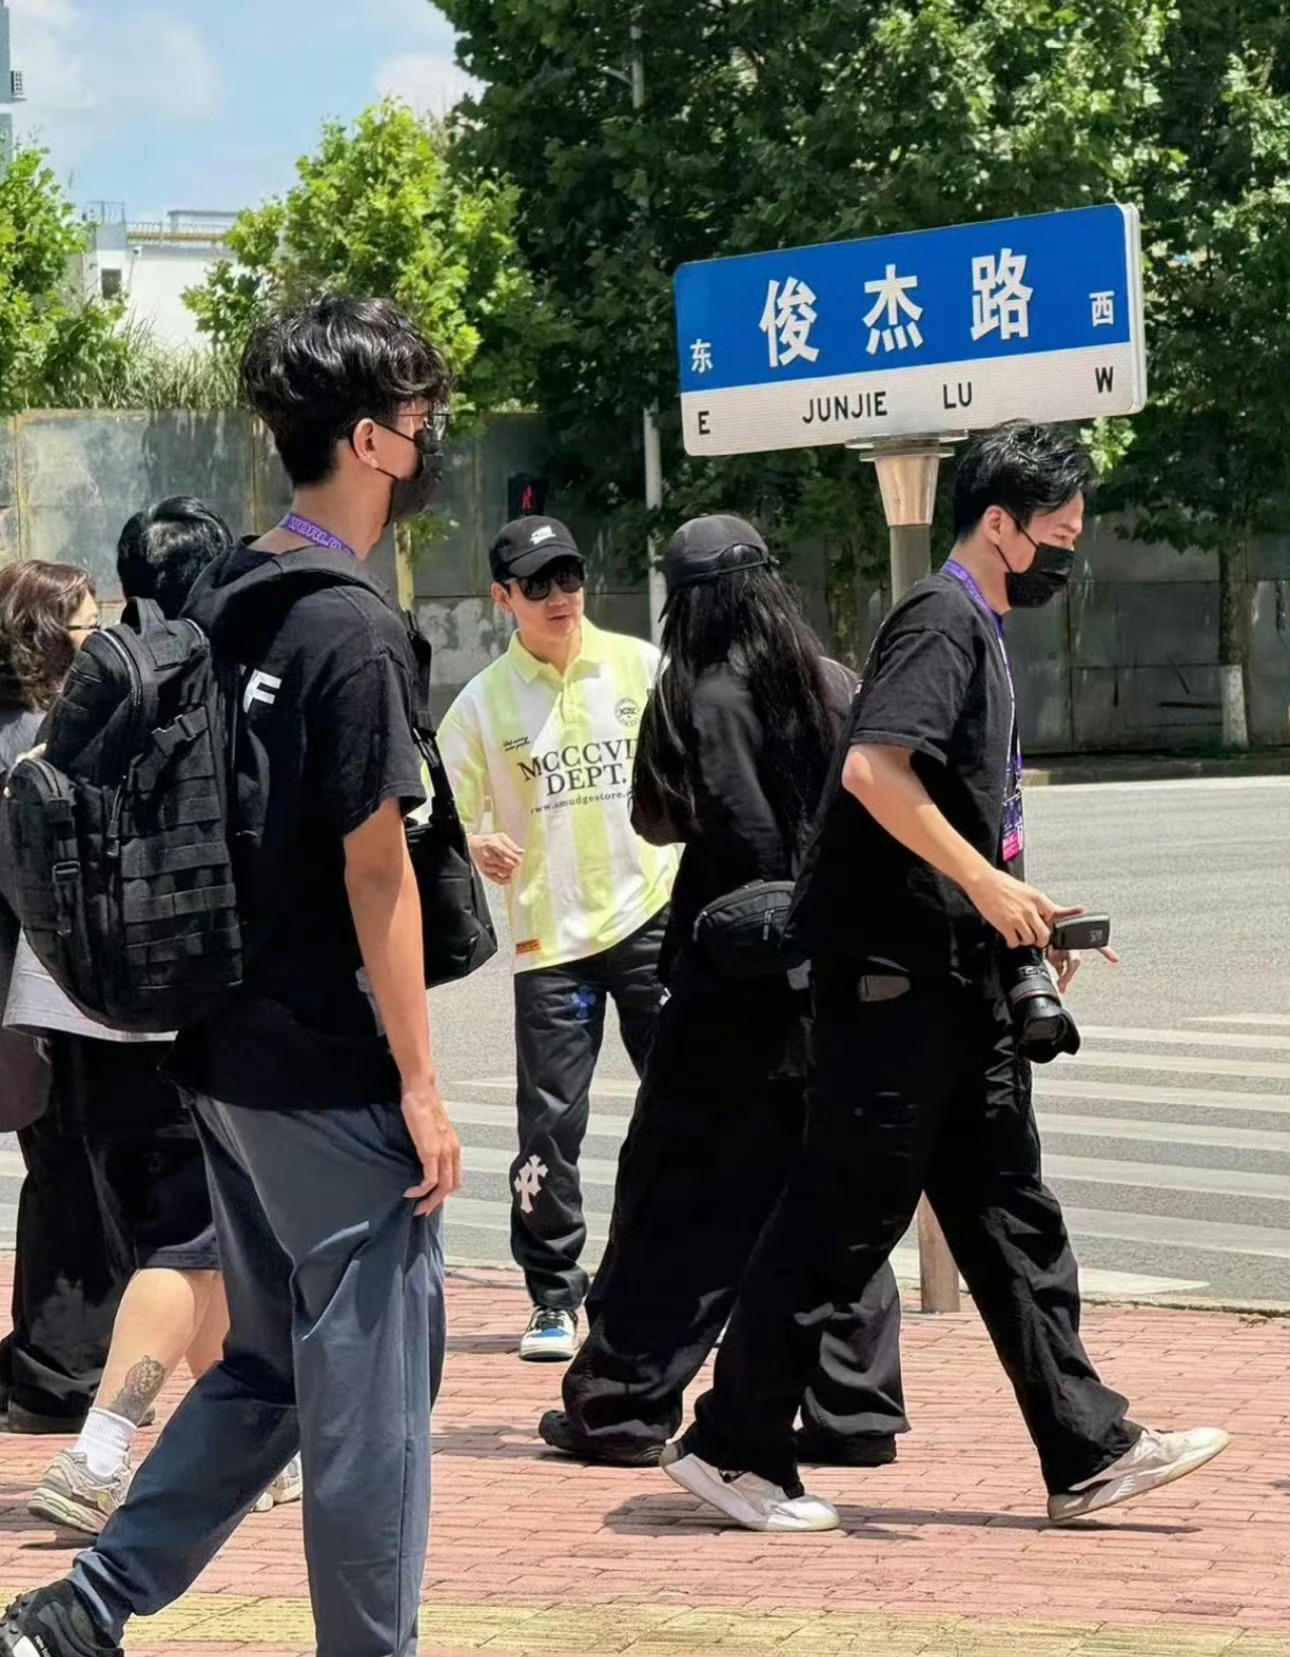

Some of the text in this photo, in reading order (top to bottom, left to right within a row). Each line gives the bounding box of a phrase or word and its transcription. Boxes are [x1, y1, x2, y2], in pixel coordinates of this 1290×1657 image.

[759, 247, 1034, 368] 俊杰路
[1089, 290, 1115, 327] 西
[690, 339, 713, 373] 东
[1095, 366, 1114, 394] W
[802, 382, 973, 424] JUNJIE LU
[698, 411, 711, 436] E
[517, 738, 637, 782] MCCCVI
[546, 763, 627, 796] DEPT.
